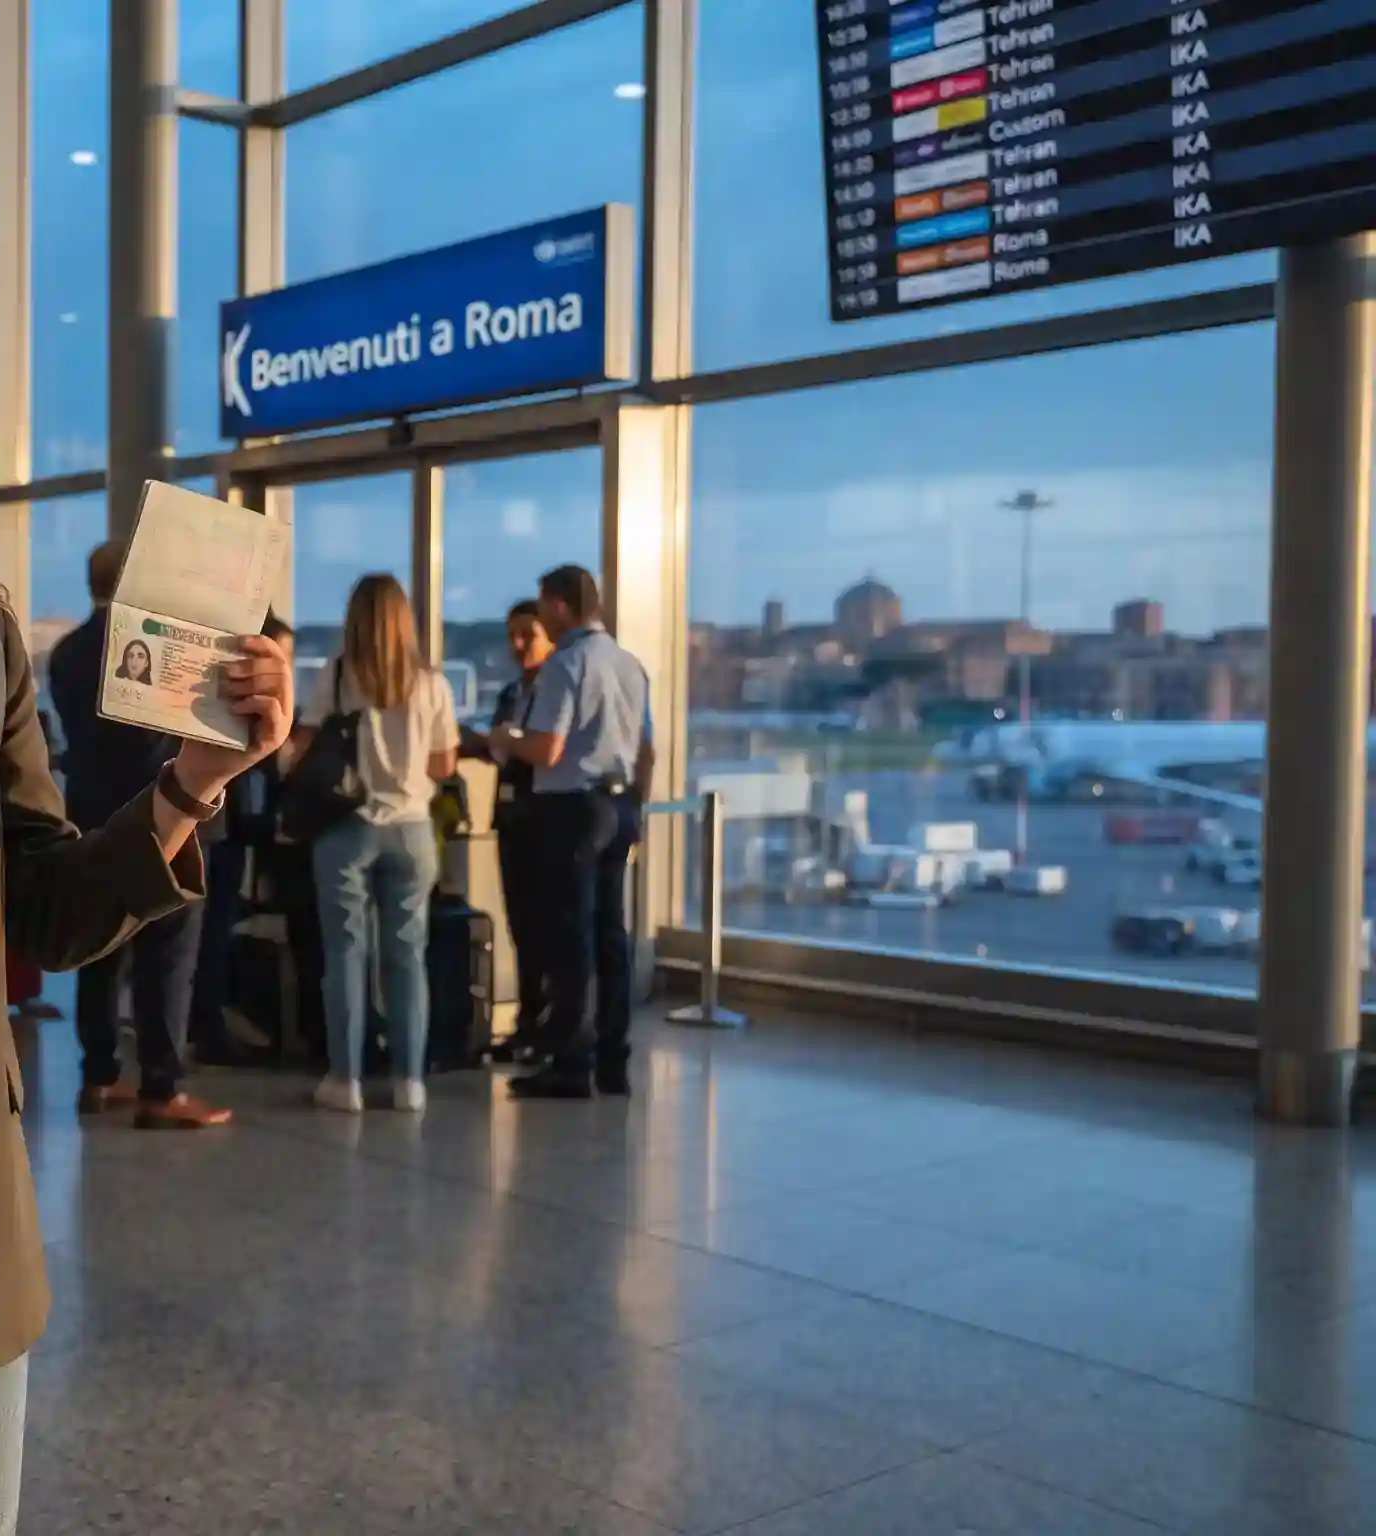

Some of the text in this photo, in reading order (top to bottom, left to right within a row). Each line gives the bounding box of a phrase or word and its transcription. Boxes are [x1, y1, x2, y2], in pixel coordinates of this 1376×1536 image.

[989, 23, 1054, 55] Tehran
[989, 54, 1055, 83] Tehran
[1171, 9, 1208, 35] IKA
[989, 40, 1209, 112] Tehran IKA
[1172, 70, 1209, 97] IKA
[992, 101, 1210, 167] Tehran IKA
[993, 131, 1211, 197] Tehran IKA
[993, 161, 1210, 224] Tehran IKA
[993, 192, 1212, 253] Roma IKA
[1175, 223, 1212, 248] IKA
[250, 313, 421, 391] Benvenuti
[430, 319, 453, 356] a
[465, 292, 582, 349] Roma
